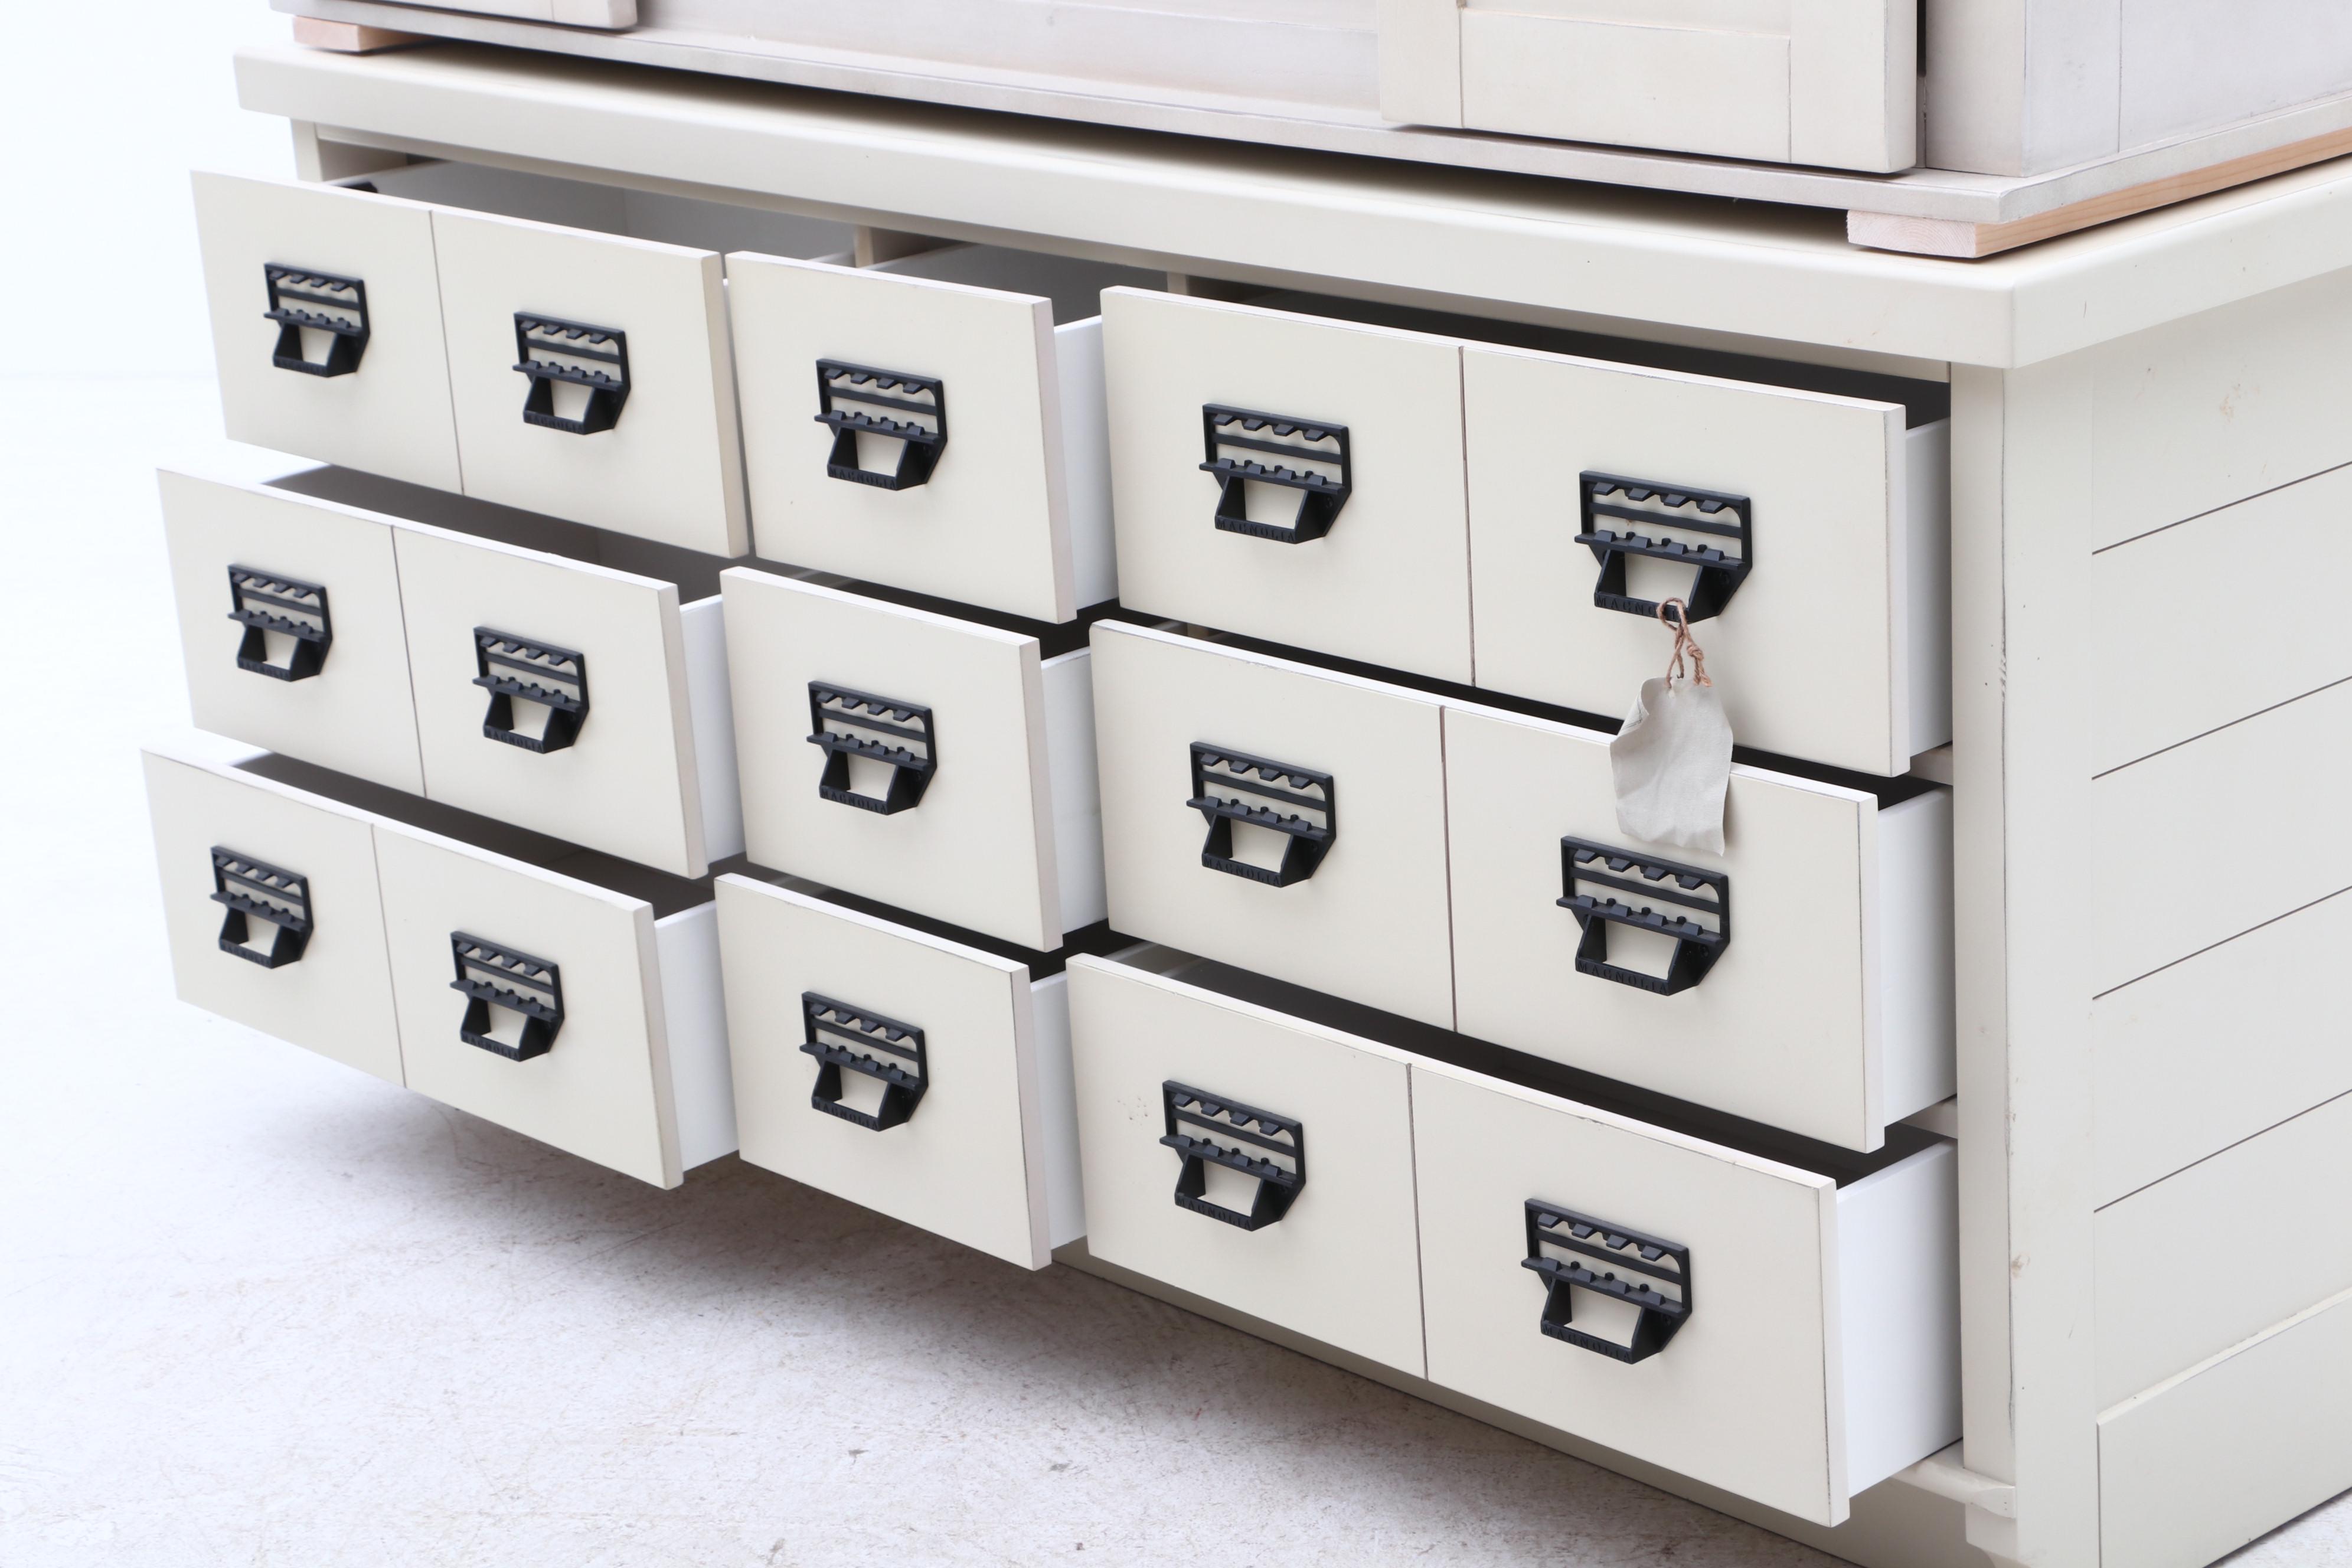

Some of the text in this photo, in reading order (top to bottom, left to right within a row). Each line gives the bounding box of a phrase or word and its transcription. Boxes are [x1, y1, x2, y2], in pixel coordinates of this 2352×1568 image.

[829, 467, 896, 489] MAGNOLIA
[1216, 520, 1295, 542] MAGNOLIA
[1596, 594, 1684, 622] MAGNOI
[821, 789, 887, 813] MAGNOLIA
[1203, 858, 1280, 886] MAGNOLIA
[1577, 962, 1668, 993] MAGNOLIA
[813, 1099, 878, 1129] MAGNOLIA
[1176, 1198, 1251, 1229] MAGNOLIA
[1543, 1326, 1631, 1360] MAGNOLIA
